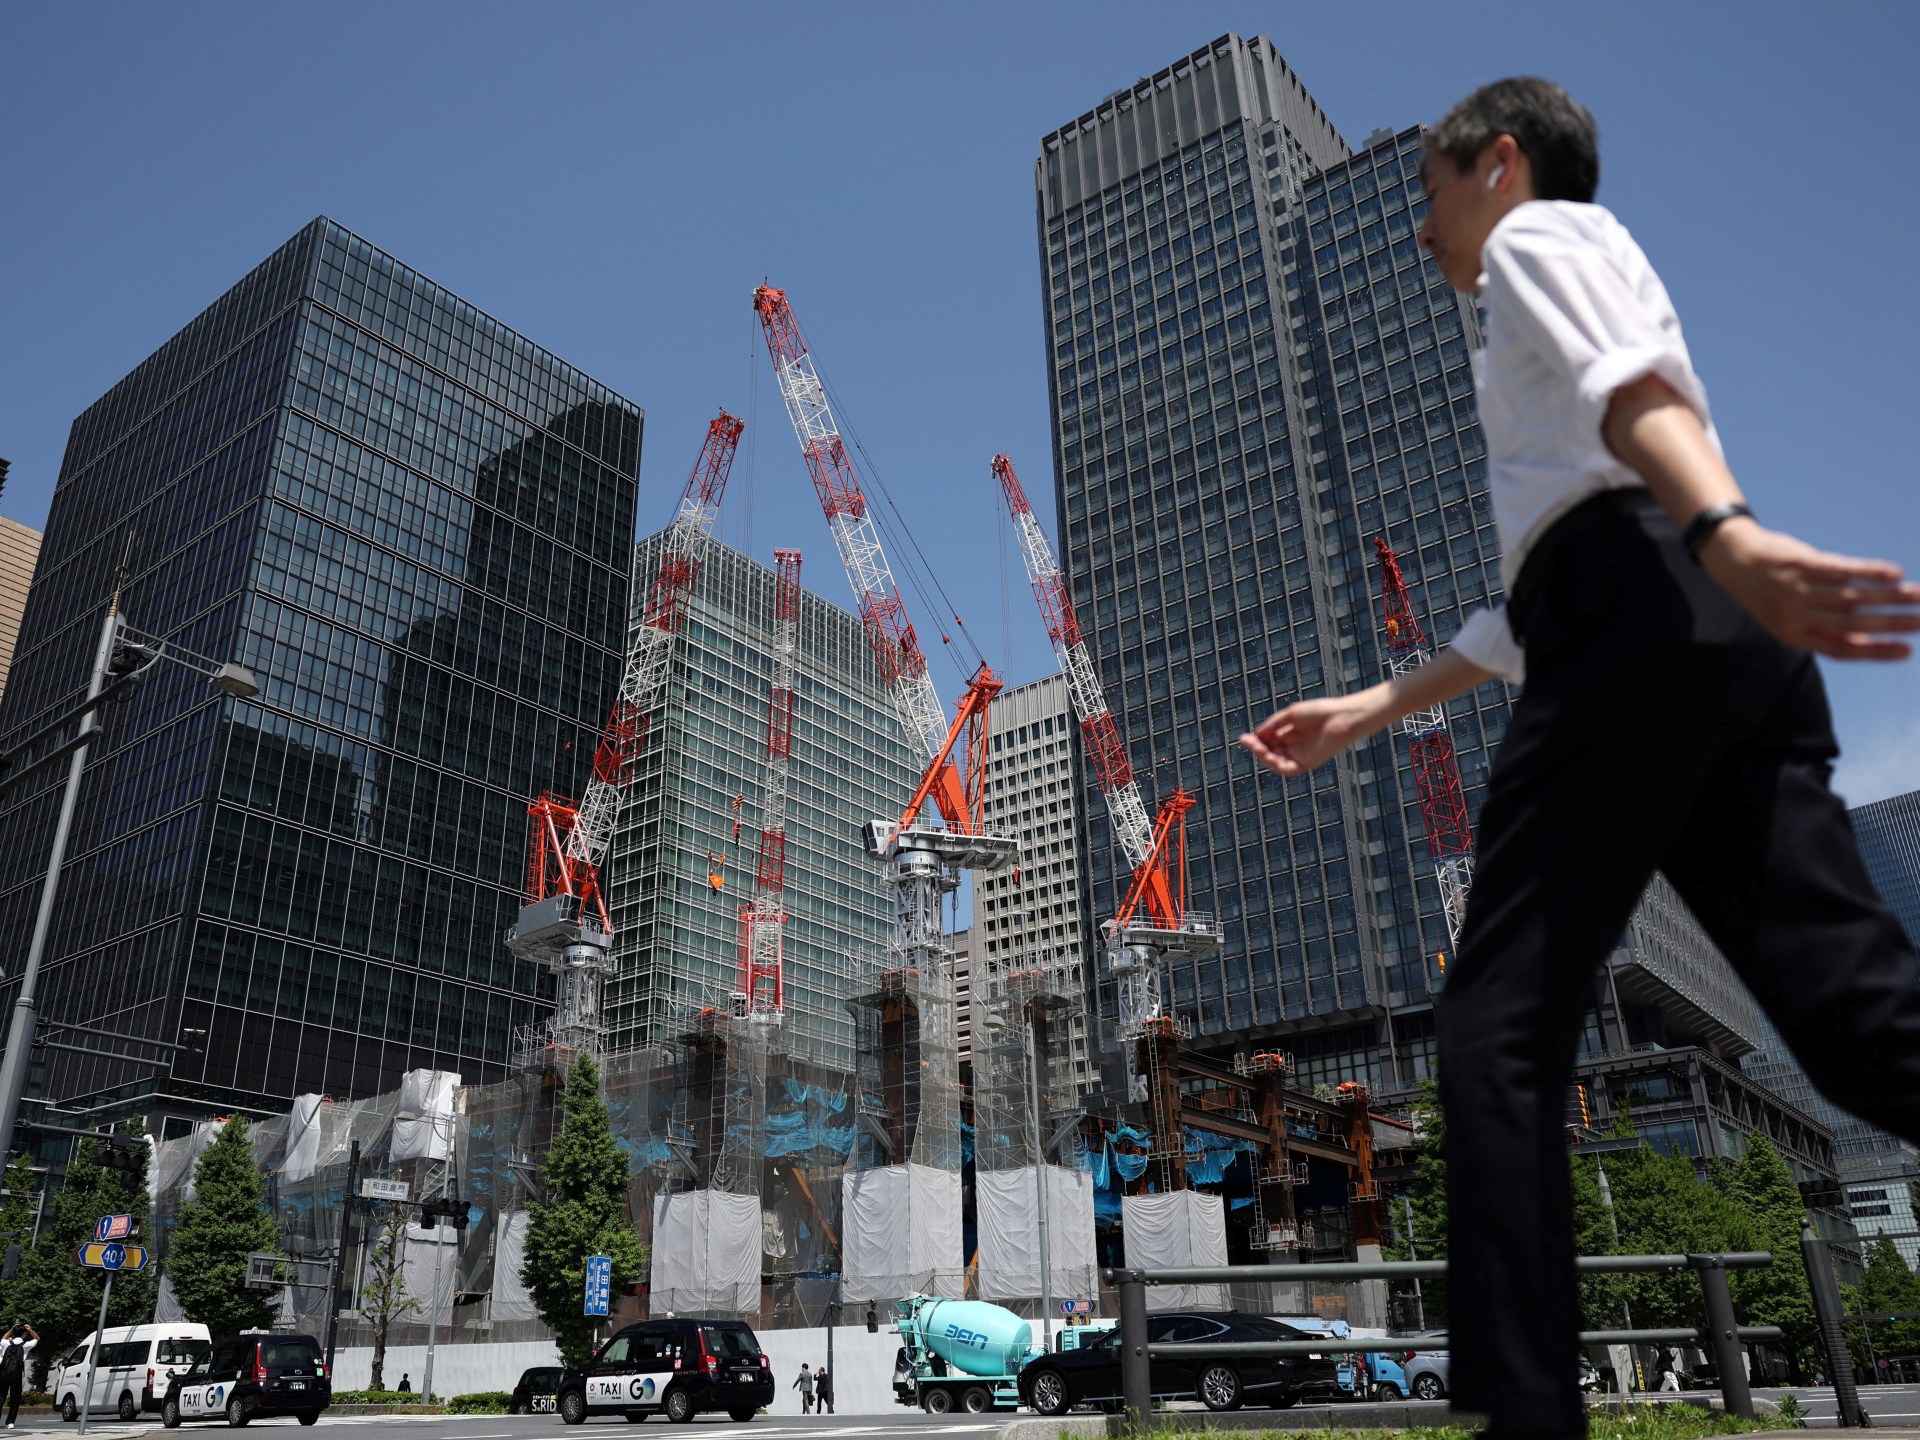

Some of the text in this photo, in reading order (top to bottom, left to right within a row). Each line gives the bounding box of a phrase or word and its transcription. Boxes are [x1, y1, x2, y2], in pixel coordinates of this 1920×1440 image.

[104, 1219, 109, 1234] 1
[103, 1250, 124, 1263] 404
[599, 1262, 609, 1311] 和田倉門
[1067, 1302, 1072, 1311] 1
[183, 1386, 224, 1408] TAXI GO
[600, 1378, 655, 1400] TAXI GO
